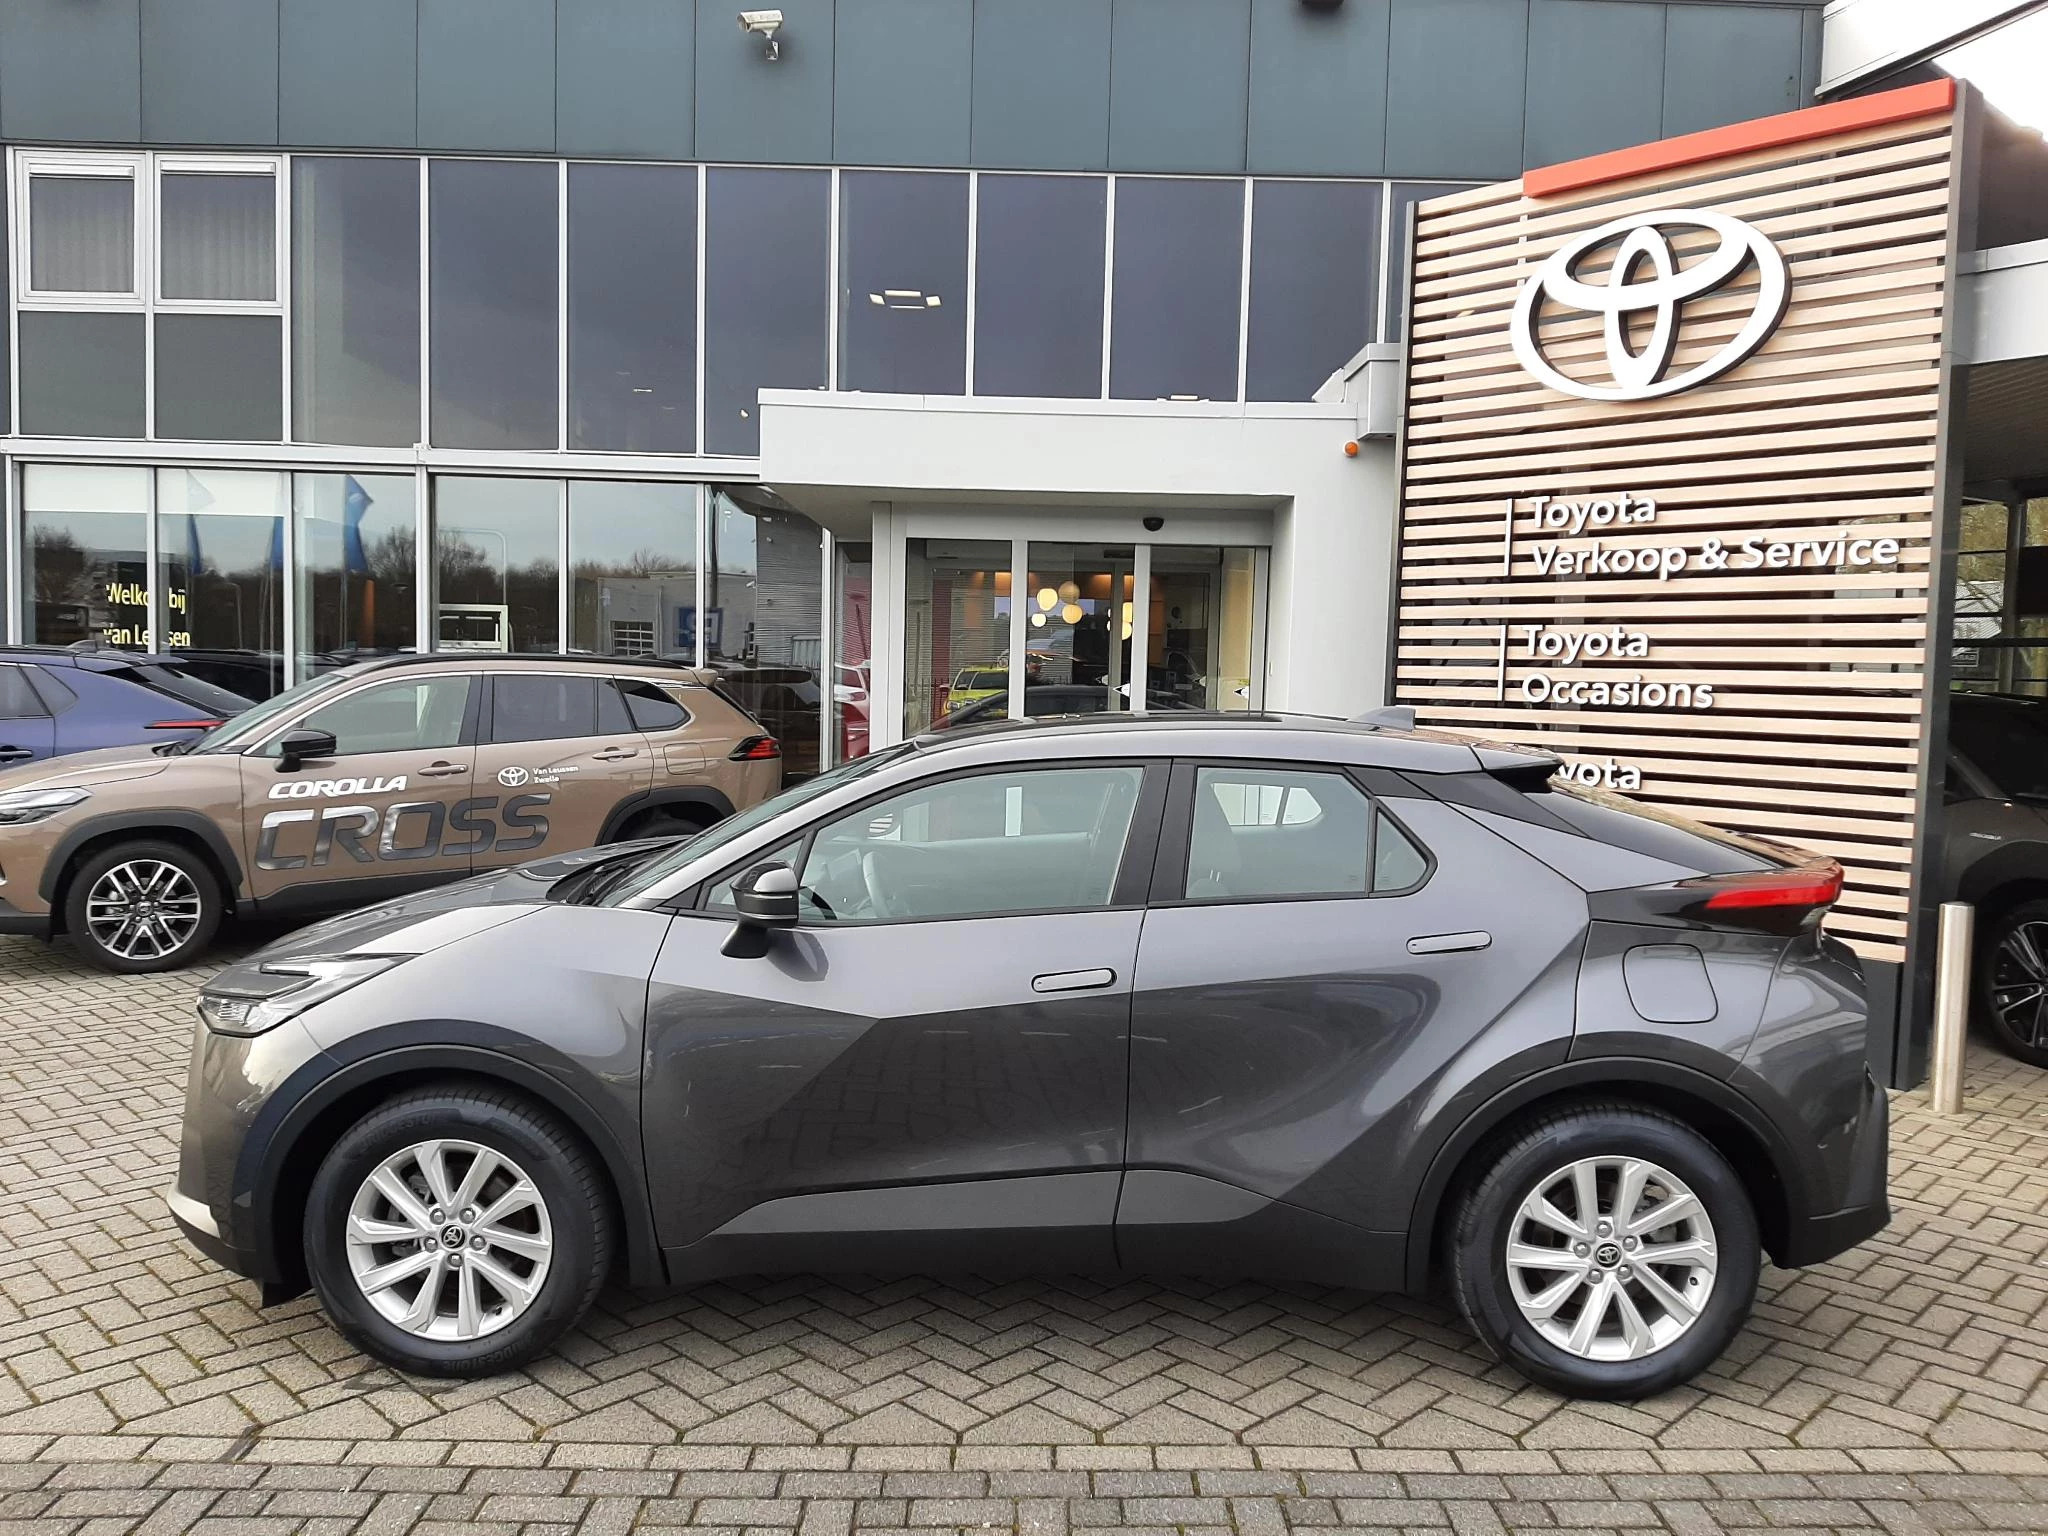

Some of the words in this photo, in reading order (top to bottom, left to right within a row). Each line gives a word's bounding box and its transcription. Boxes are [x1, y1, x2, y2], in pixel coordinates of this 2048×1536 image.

[1530, 492, 1656, 534] Toyota
[1532, 541, 1688, 581] Verkoop
[1699, 536, 1730, 570] &
[1743, 530, 1900, 568] Service
[105, 582, 148, 606] Welko
[168, 587, 186, 614] bij
[134, 623, 191, 647] Lesen
[1522, 624, 1650, 665] Toyota
[1521, 673, 1714, 709] Occasions
[267, 775, 408, 799] COROLLA
[533, 767, 548, 775] Van
[1556, 758, 1642, 790] yota
[255, 793, 552, 870] CROSS
